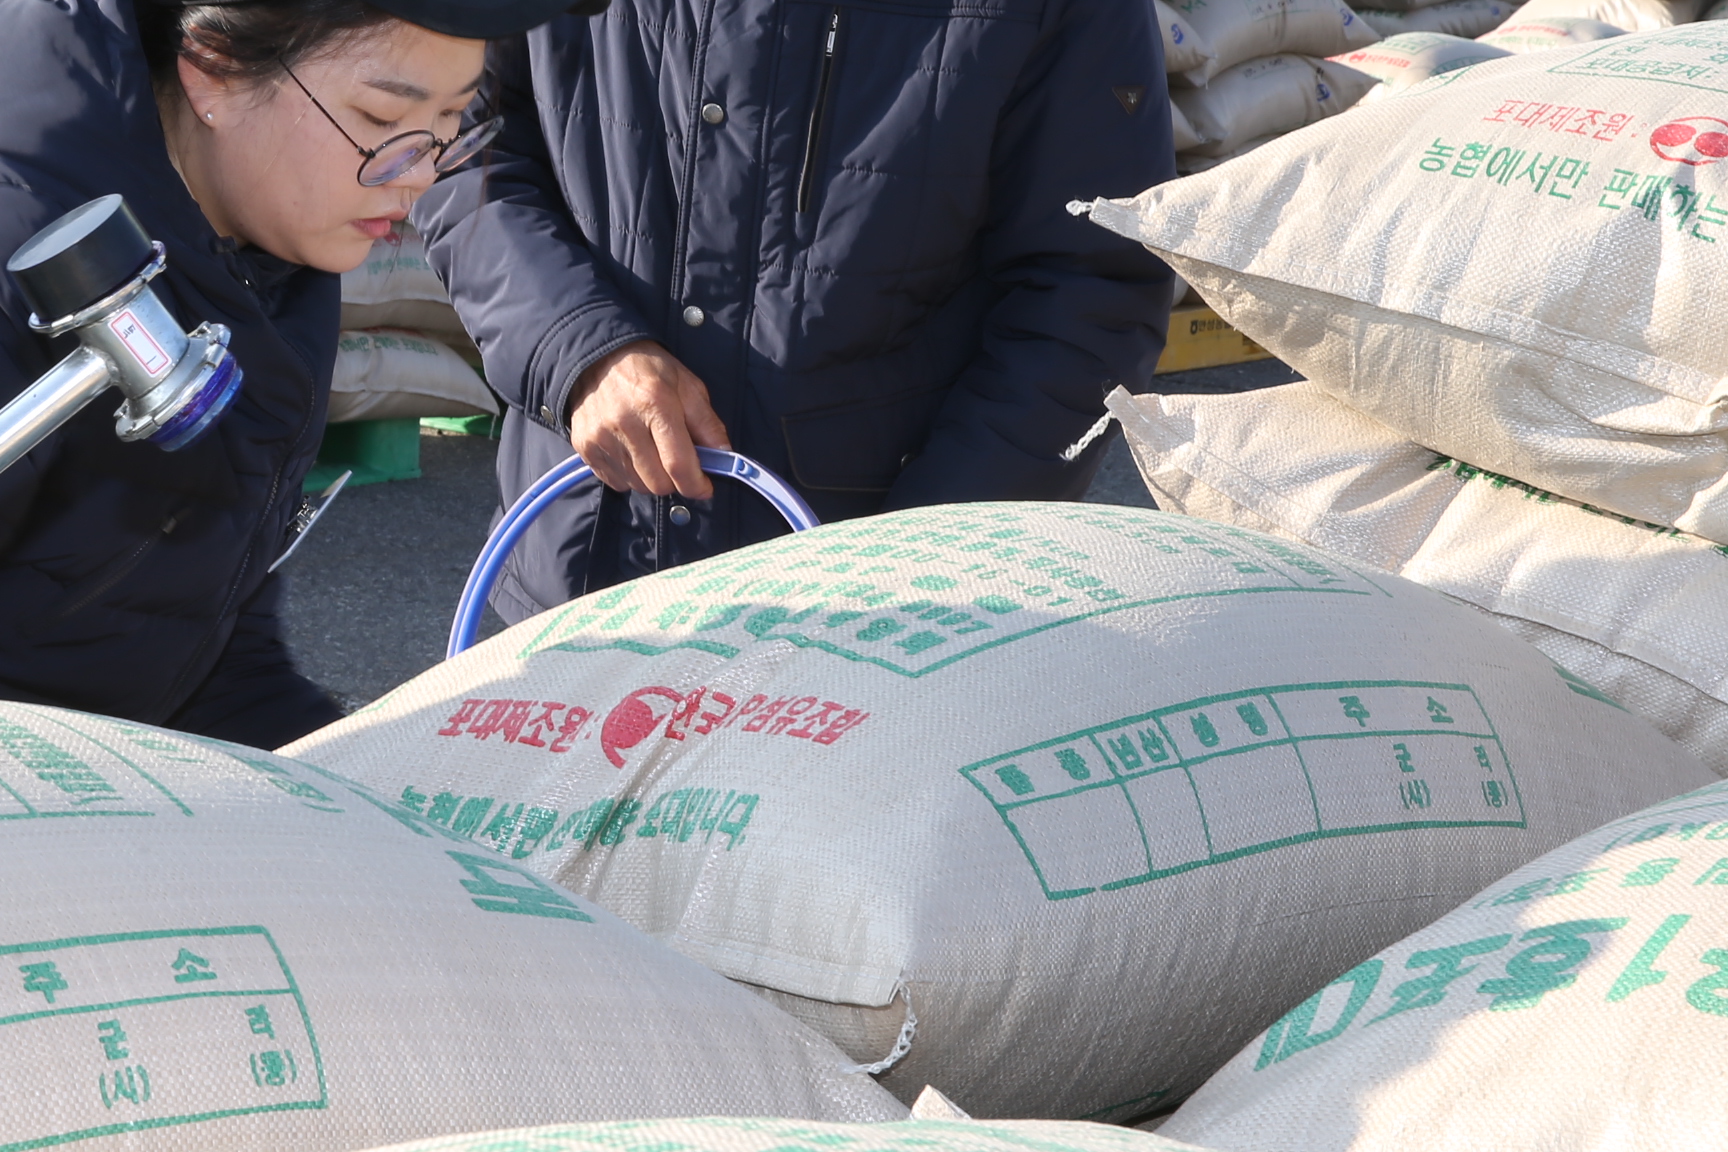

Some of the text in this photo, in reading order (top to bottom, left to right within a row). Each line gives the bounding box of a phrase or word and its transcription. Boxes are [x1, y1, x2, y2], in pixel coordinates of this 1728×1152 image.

[1419, 137, 1728, 244] 농협에서만 판매하는
[1339, 695, 1370, 727] 주
[1427, 696, 1455, 724] 소
[19, 961, 69, 1003] 주
[171, 948, 218, 984] 소
[97, 1019, 130, 1060] 군
[98, 1064, 150, 1109] (시)
